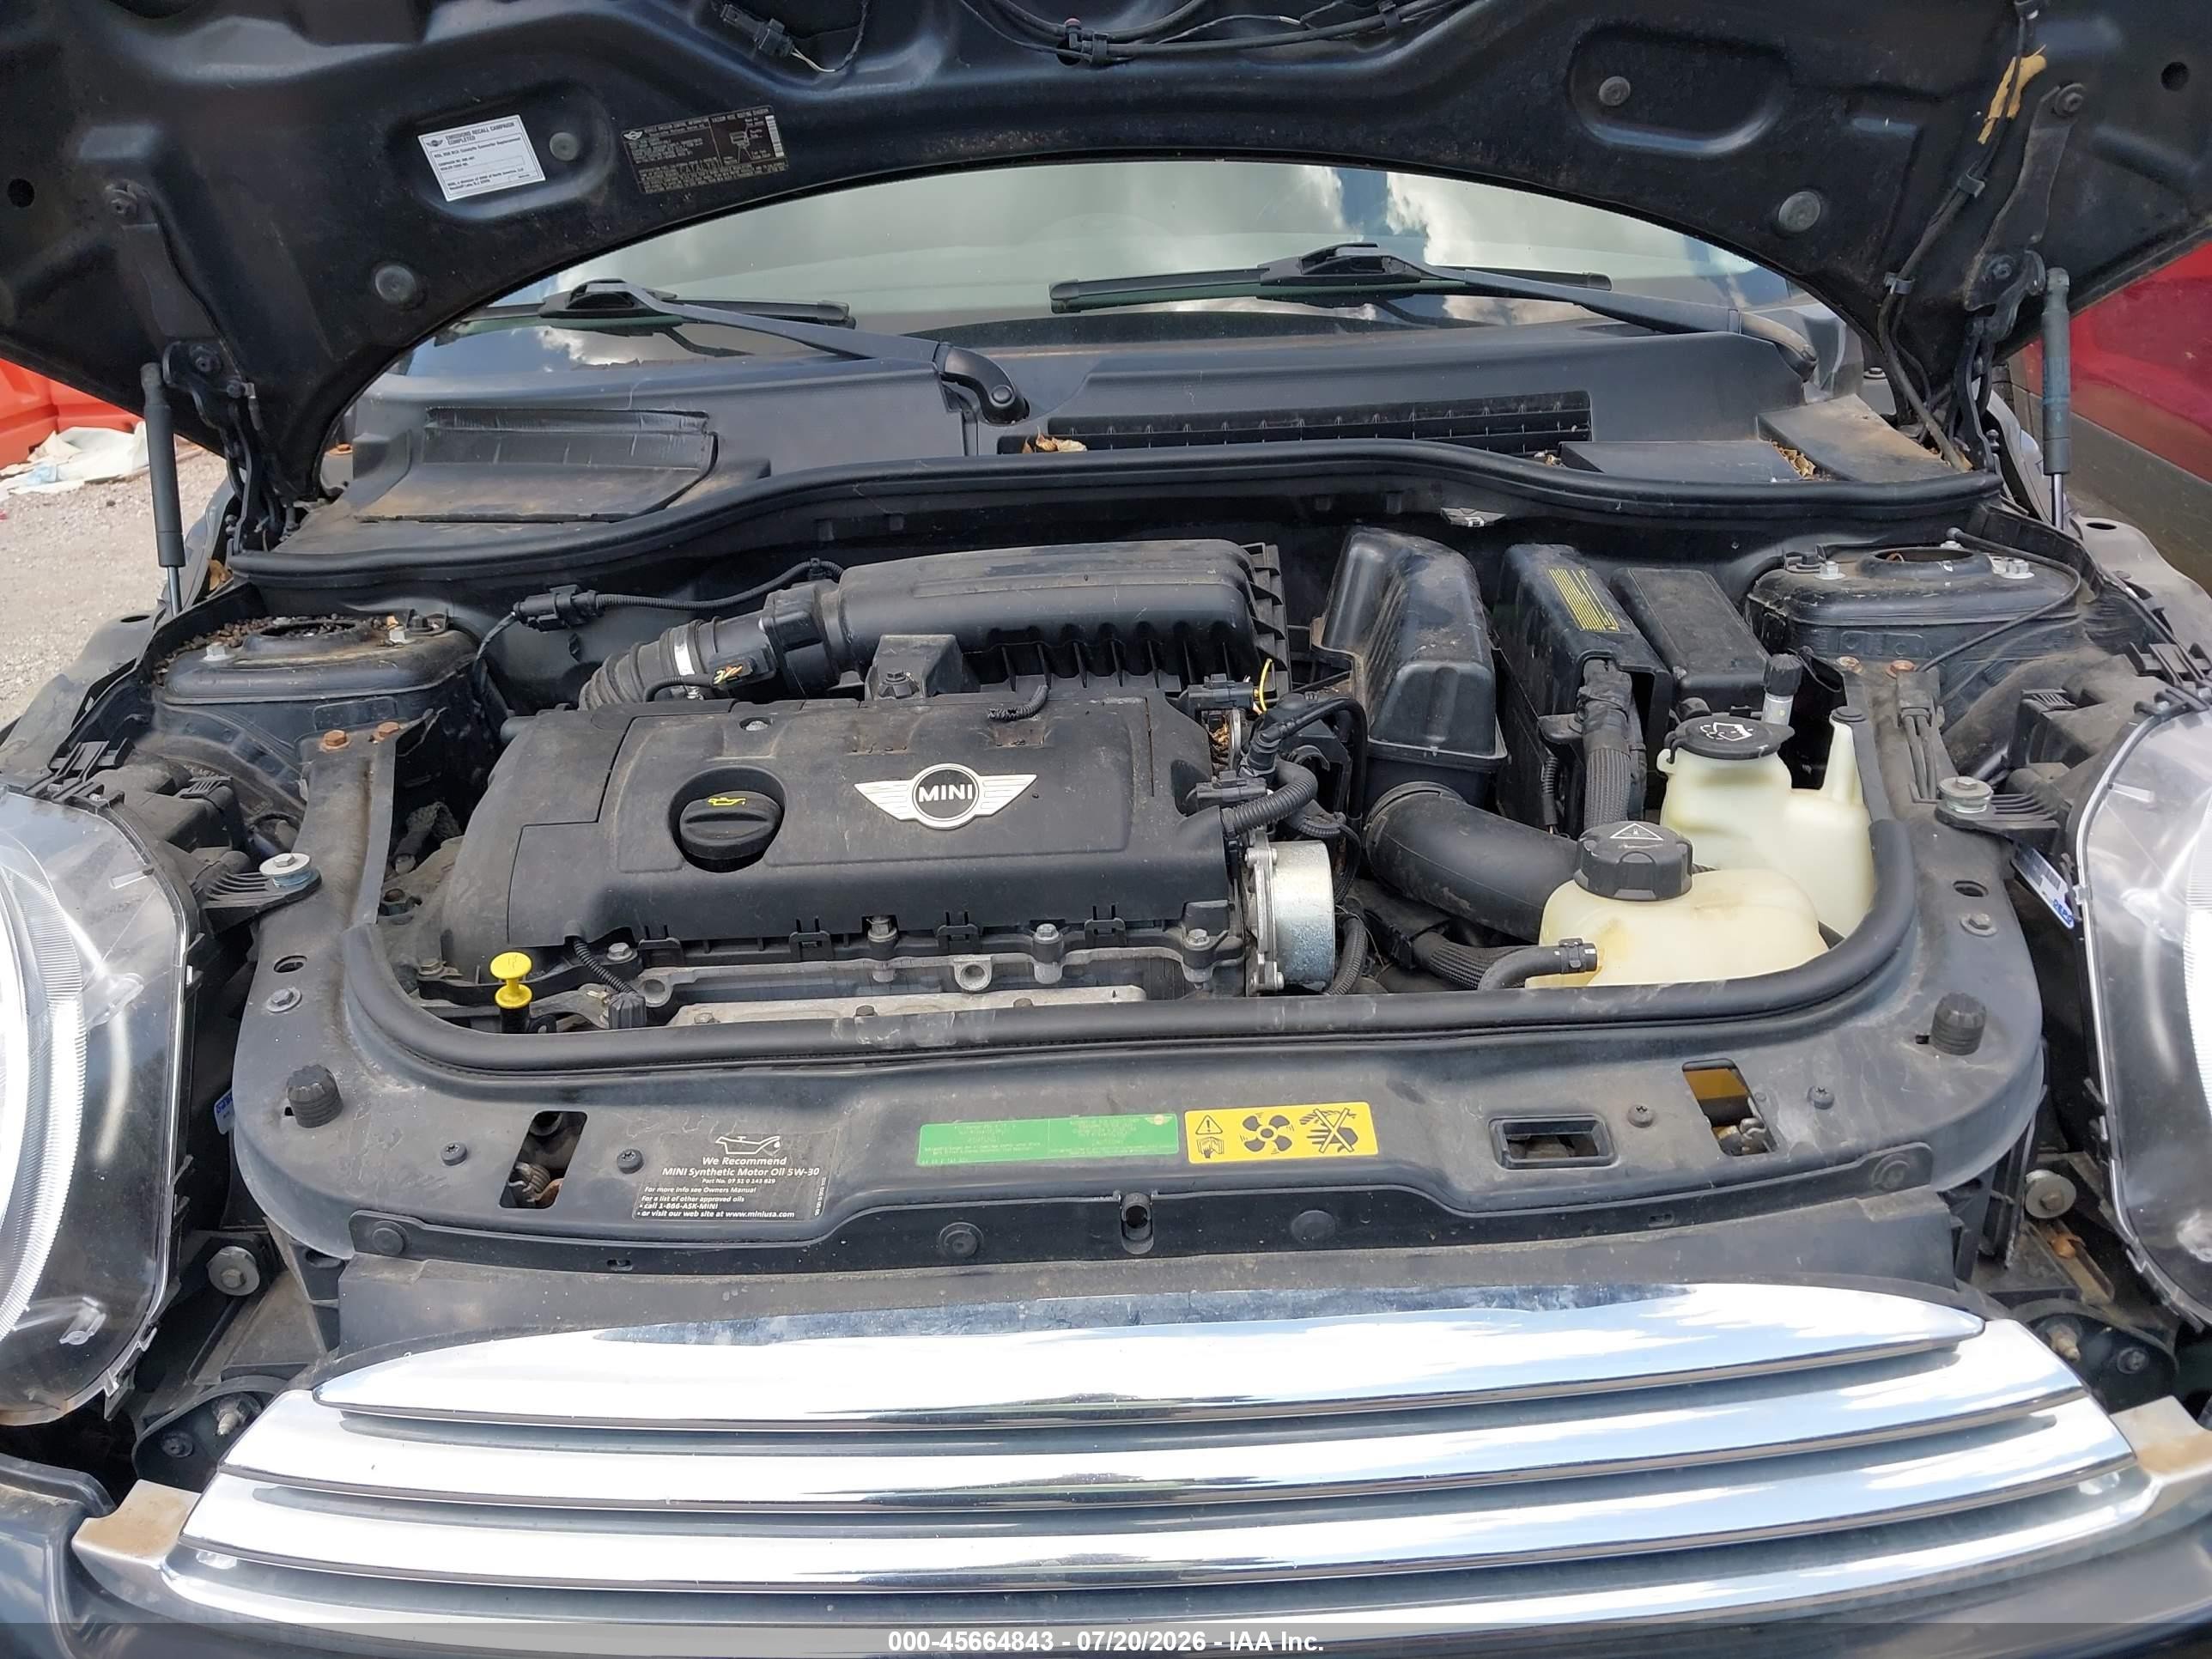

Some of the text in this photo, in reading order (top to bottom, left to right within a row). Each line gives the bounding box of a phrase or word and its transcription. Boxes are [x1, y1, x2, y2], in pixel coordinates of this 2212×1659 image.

[471, 126, 489, 135] RECALL
[917, 783, 973, 803] MINI
[702, 1157, 787, 1166] We Recommend
[689, 1167, 735, 1177] Synthetic
[737, 1168, 769, 1176] Motor
[770, 1168, 785, 1176] Oil
[787, 1167, 820, 1176] 5W-30
